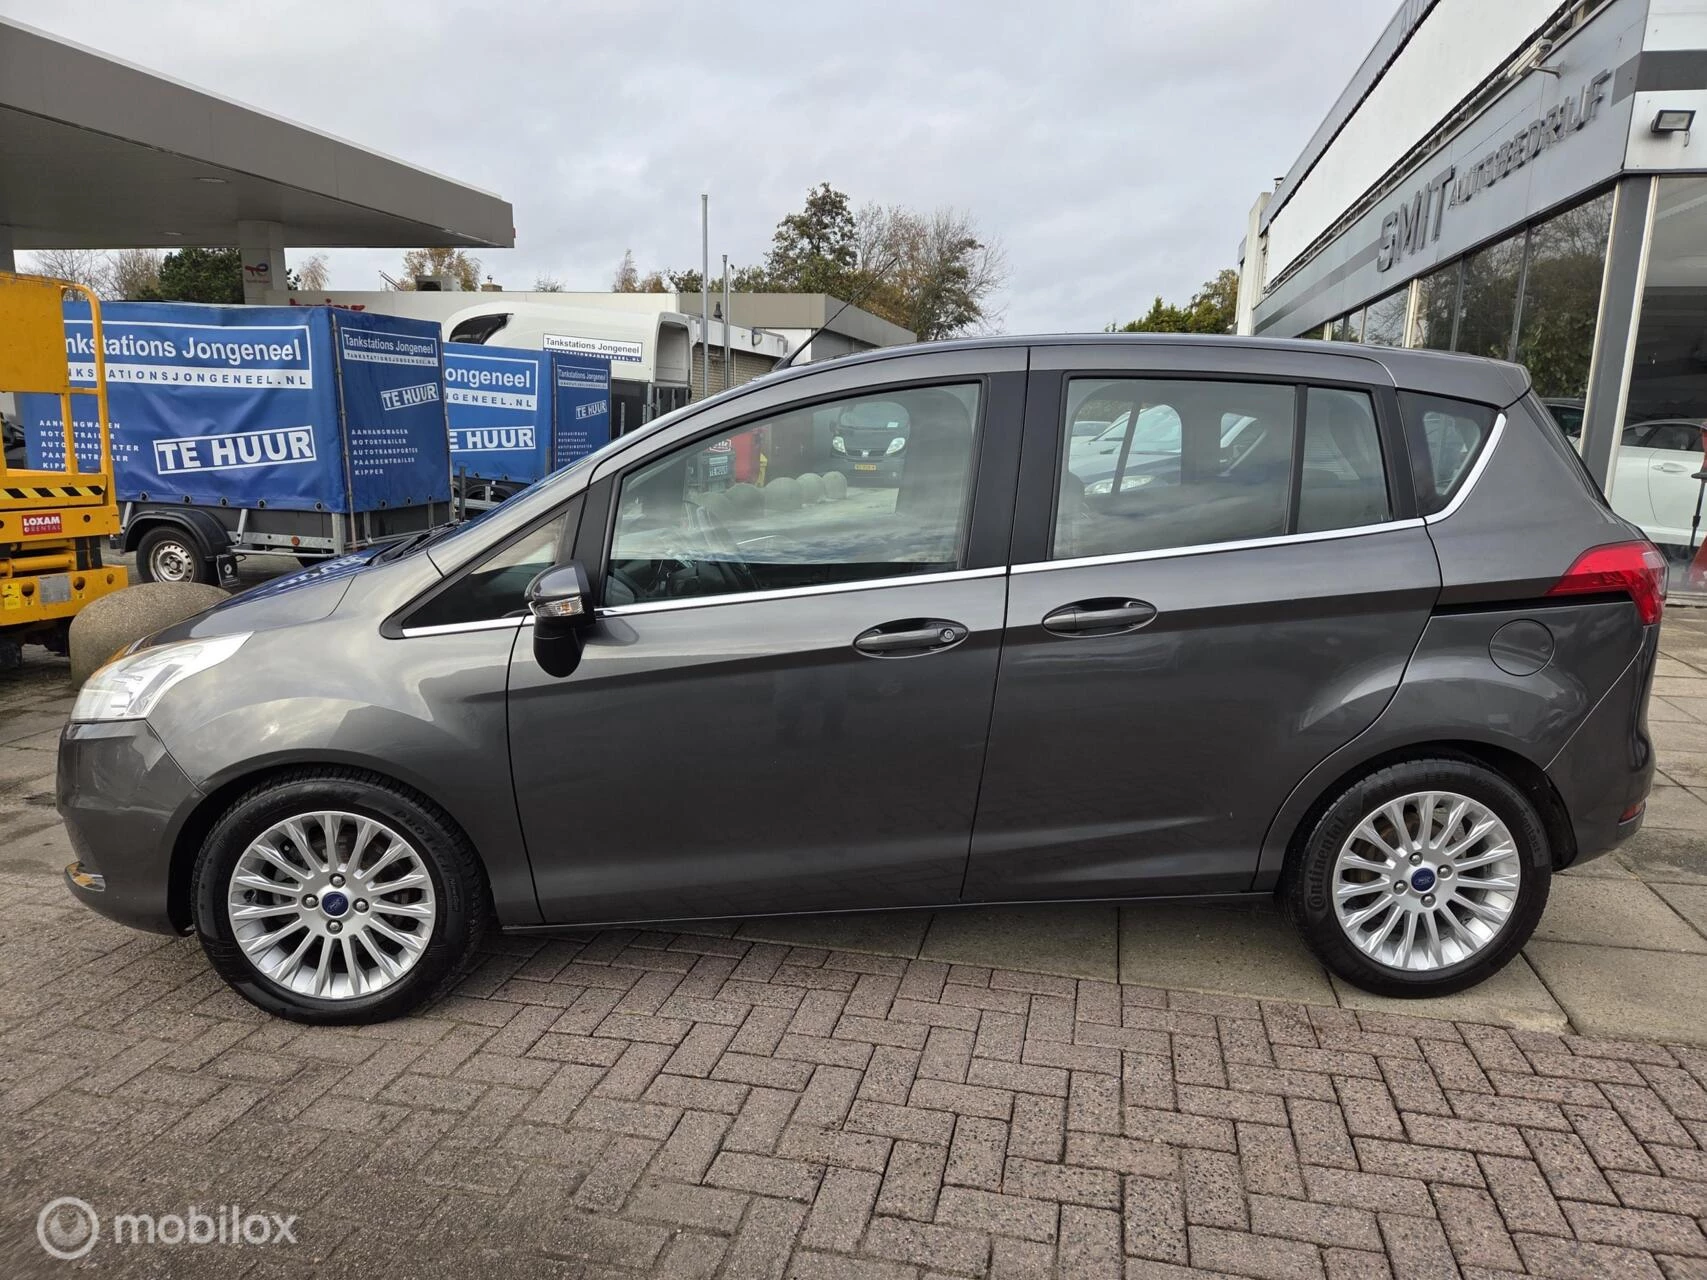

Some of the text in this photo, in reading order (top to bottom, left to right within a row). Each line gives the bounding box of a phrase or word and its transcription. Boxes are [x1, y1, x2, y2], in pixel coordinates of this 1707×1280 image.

[1377, 164, 1456, 273] SMIT
[182, 336, 302, 366] Jongeneel
[344, 334, 434, 355] Tankstations Jongeneel
[545, 337, 640, 354] Tankstations Jongeneel
[445, 367, 531, 388] ongeneel
[382, 385, 437, 408] TE HUUR
[576, 406, 587, 418] TE
[466, 428, 534, 449] HUUR
[157, 430, 314, 471] TE HUUR
[23, 516, 61, 526] LOXAM
